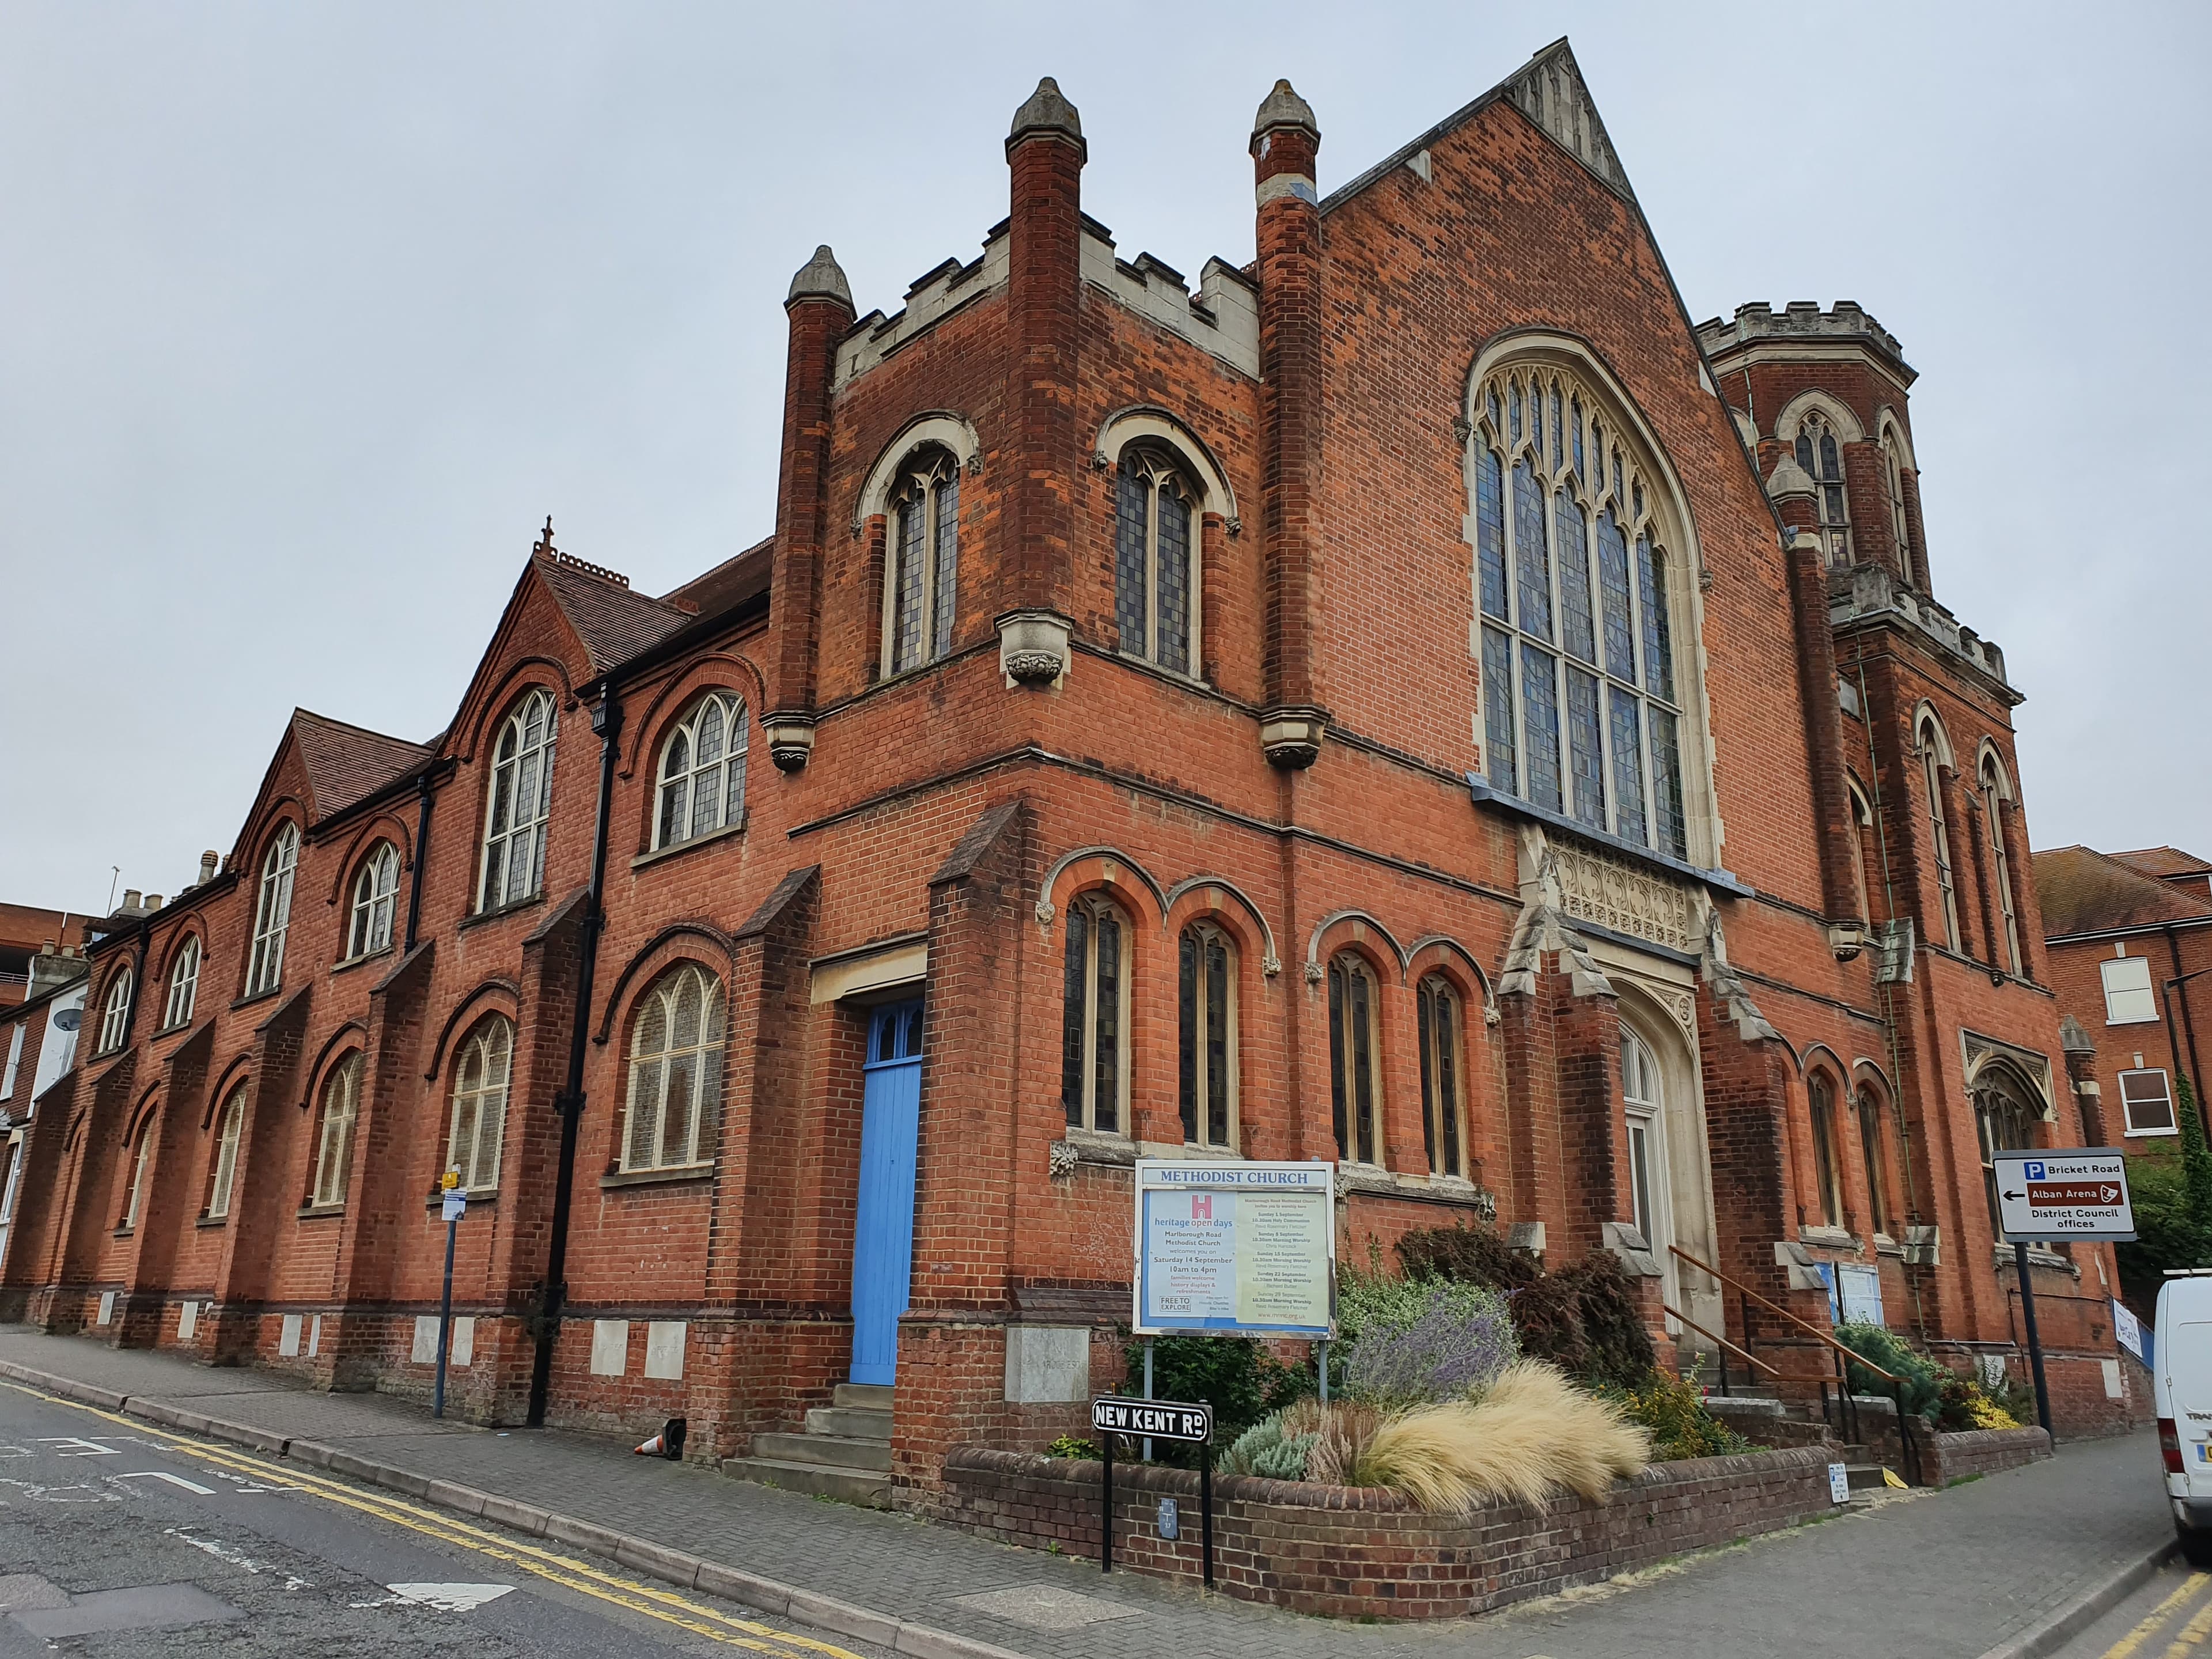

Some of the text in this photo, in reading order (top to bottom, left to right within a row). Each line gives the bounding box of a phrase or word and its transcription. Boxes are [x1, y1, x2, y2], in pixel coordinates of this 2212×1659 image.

[2048, 1165, 2088, 1174] Bricket
[2092, 1165, 2120, 1173] Road
[1161, 1171, 1308, 1184] METHODIST CHURCH
[2032, 1190, 2097, 1199] Alban Arena
[2032, 1209, 2119, 1218] District Council
[1155, 1218, 1233, 1228] heritage open days
[2057, 1220, 2094, 1228] offices
[1096, 1406, 1127, 1427] NEW
[1132, 1409, 1176, 1432] KENT
